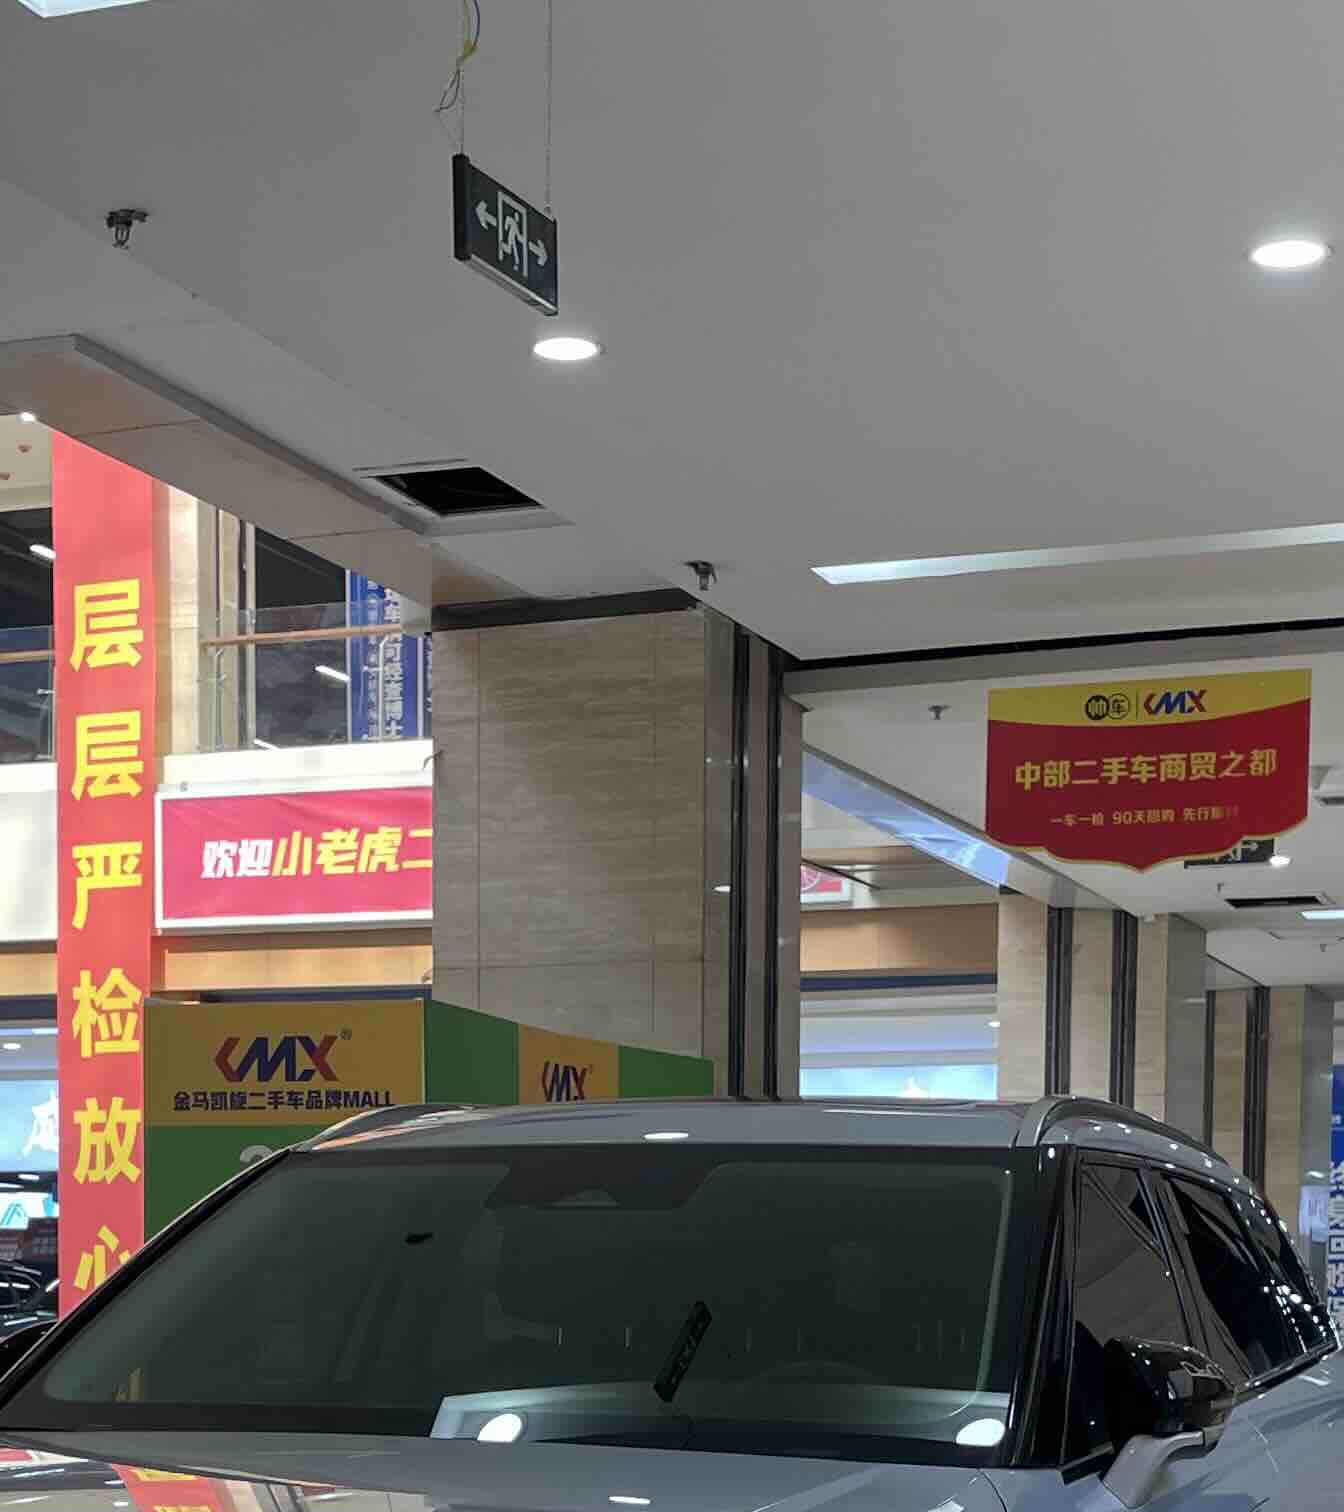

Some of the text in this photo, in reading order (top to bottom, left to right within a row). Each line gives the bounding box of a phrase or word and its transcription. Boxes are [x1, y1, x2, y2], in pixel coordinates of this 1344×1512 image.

[1015, 748, 1278, 790] 中部二手车商贸之都
[201, 826, 433, 879] 欢迎小老虎二
[70, 579, 146, 1294] 层层严检放心
